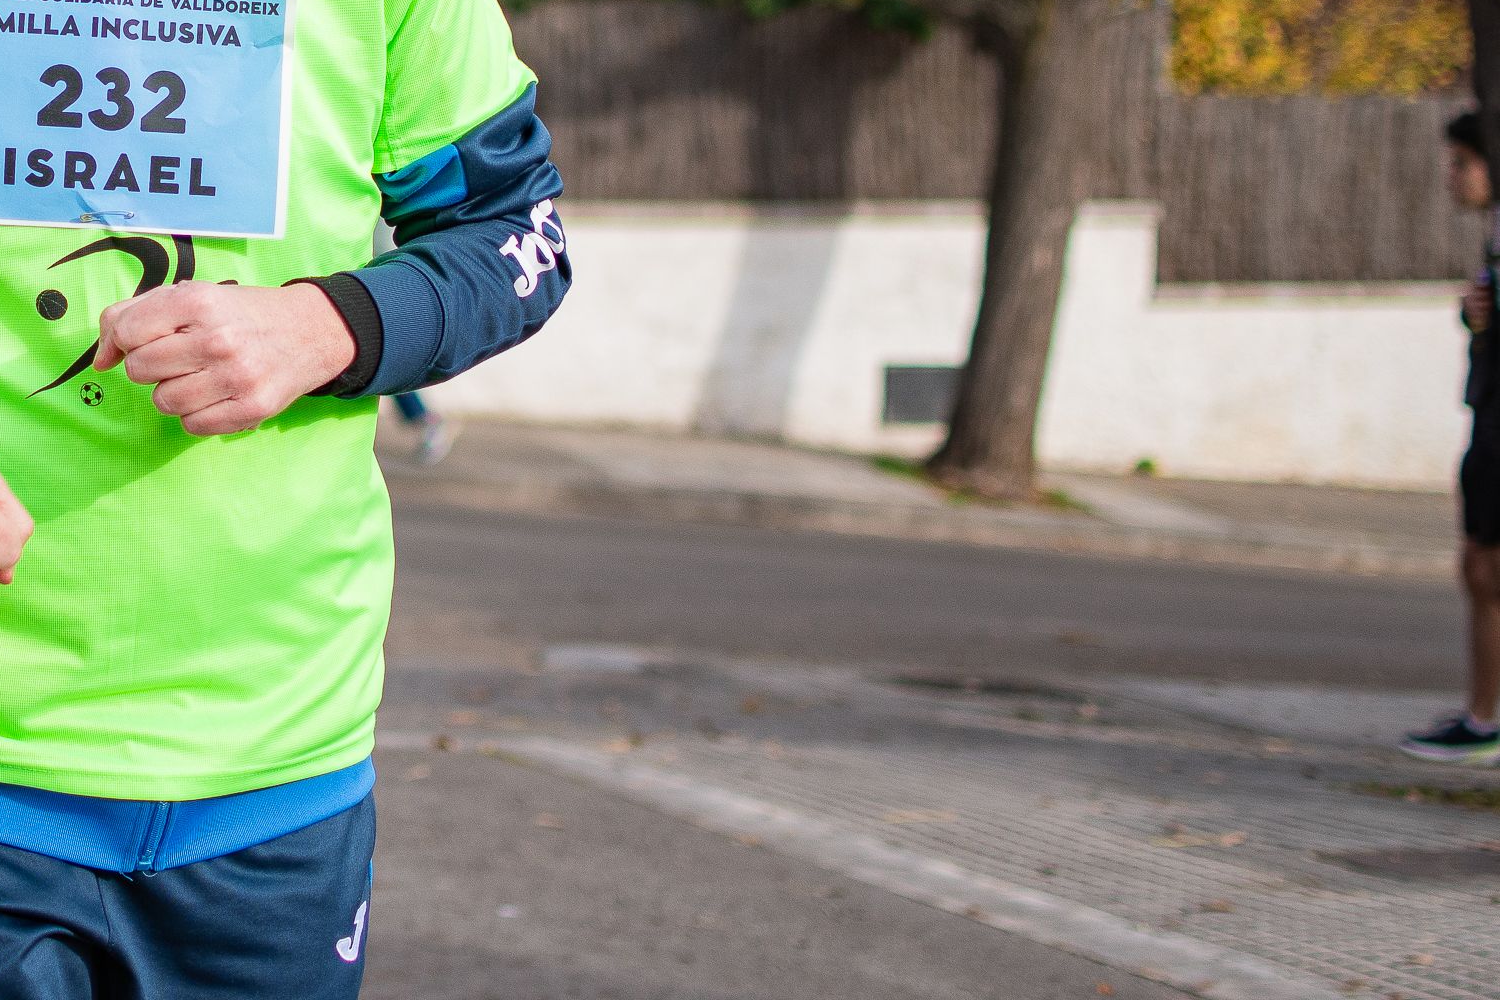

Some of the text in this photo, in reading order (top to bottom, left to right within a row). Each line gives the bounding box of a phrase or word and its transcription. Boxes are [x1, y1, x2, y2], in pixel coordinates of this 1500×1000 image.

[91, 18, 242, 48] INCLUSIVA
[36, 63, 187, 135] 232
[3, 147, 217, 197] ISRAEL
